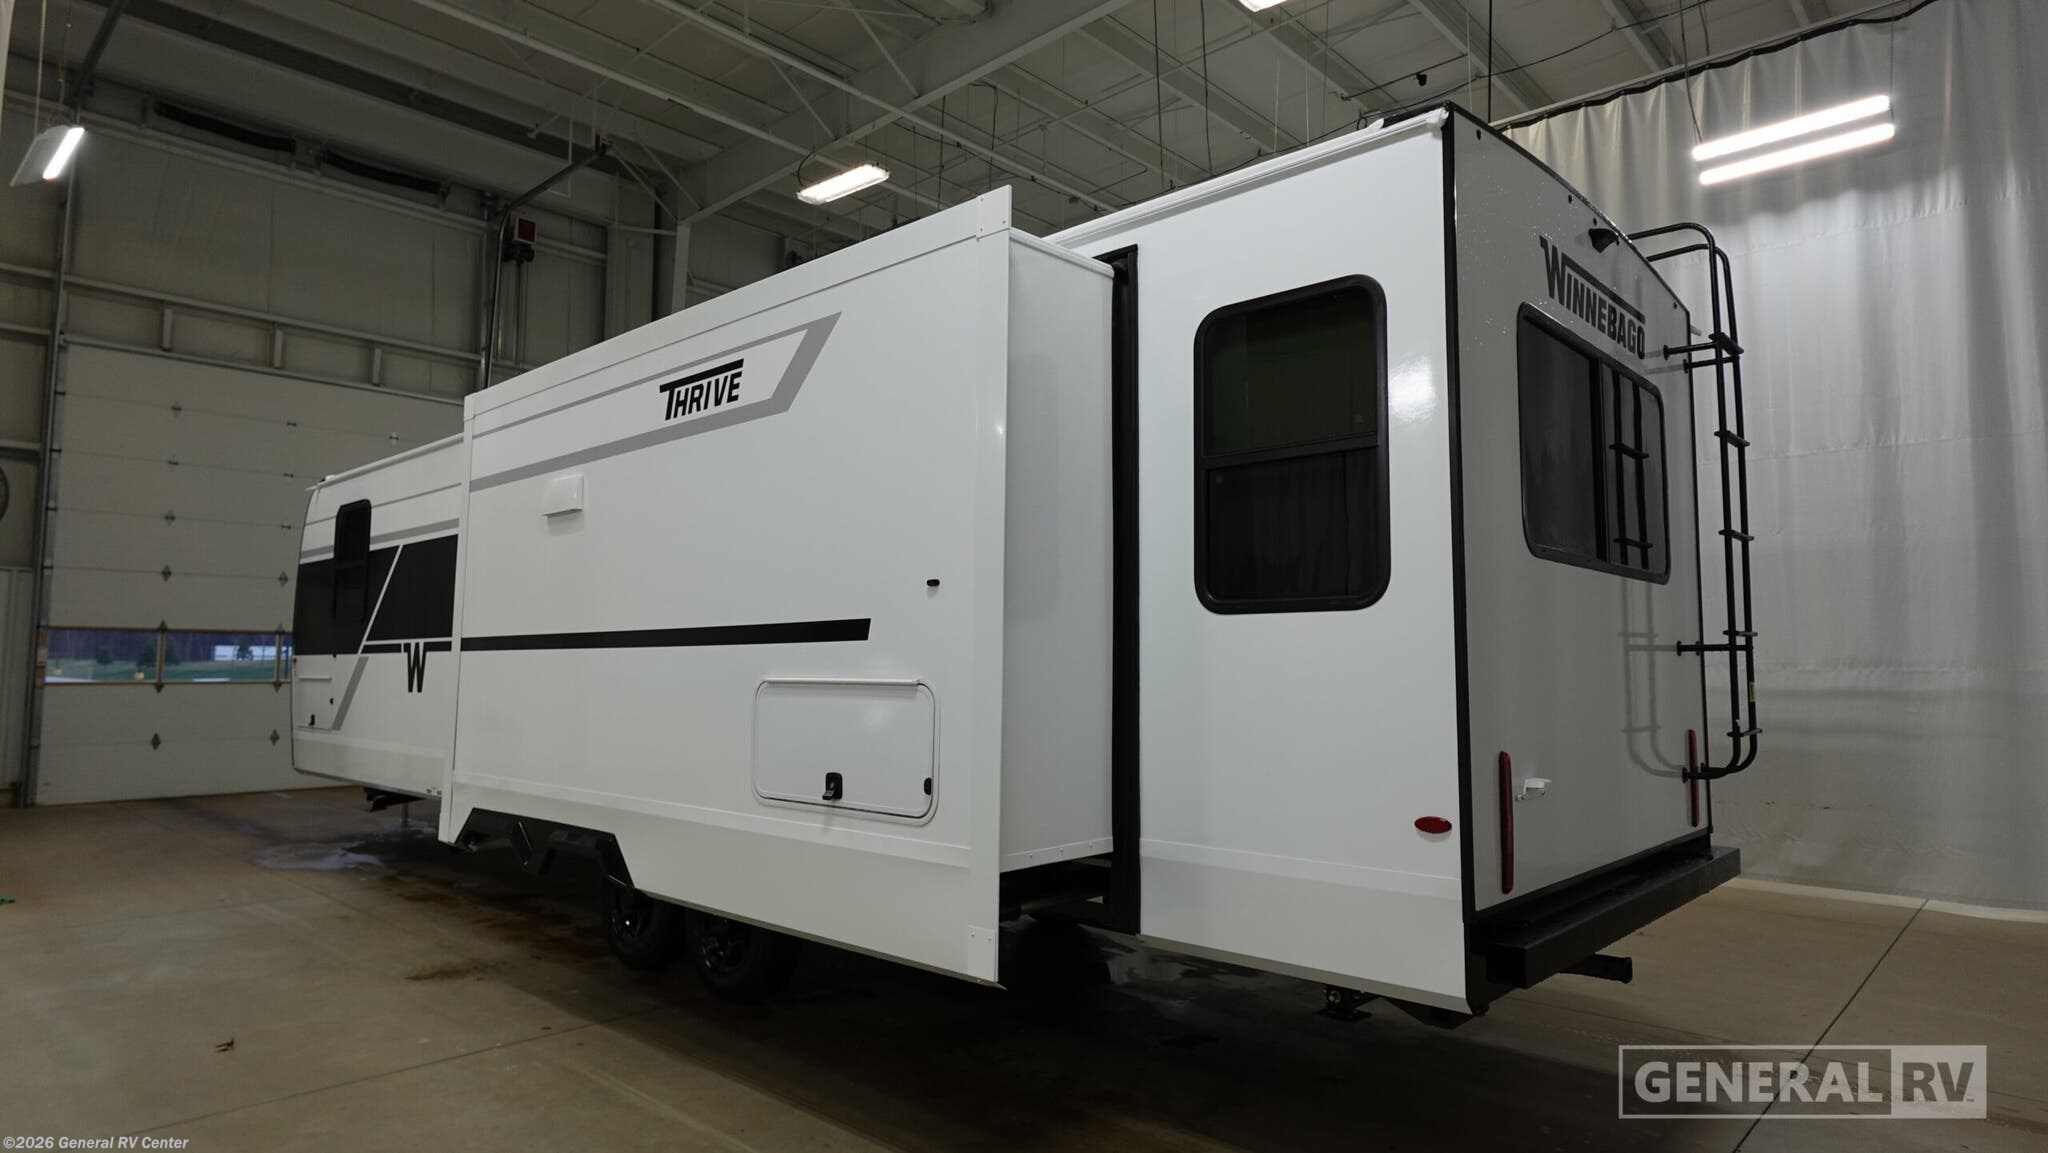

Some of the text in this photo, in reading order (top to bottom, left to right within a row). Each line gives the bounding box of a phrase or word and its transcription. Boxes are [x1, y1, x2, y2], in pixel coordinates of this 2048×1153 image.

[1539, 235, 1646, 360] WINNEBAGO
[659, 358, 744, 421] THRIVE
[403, 641, 428, 693] W
